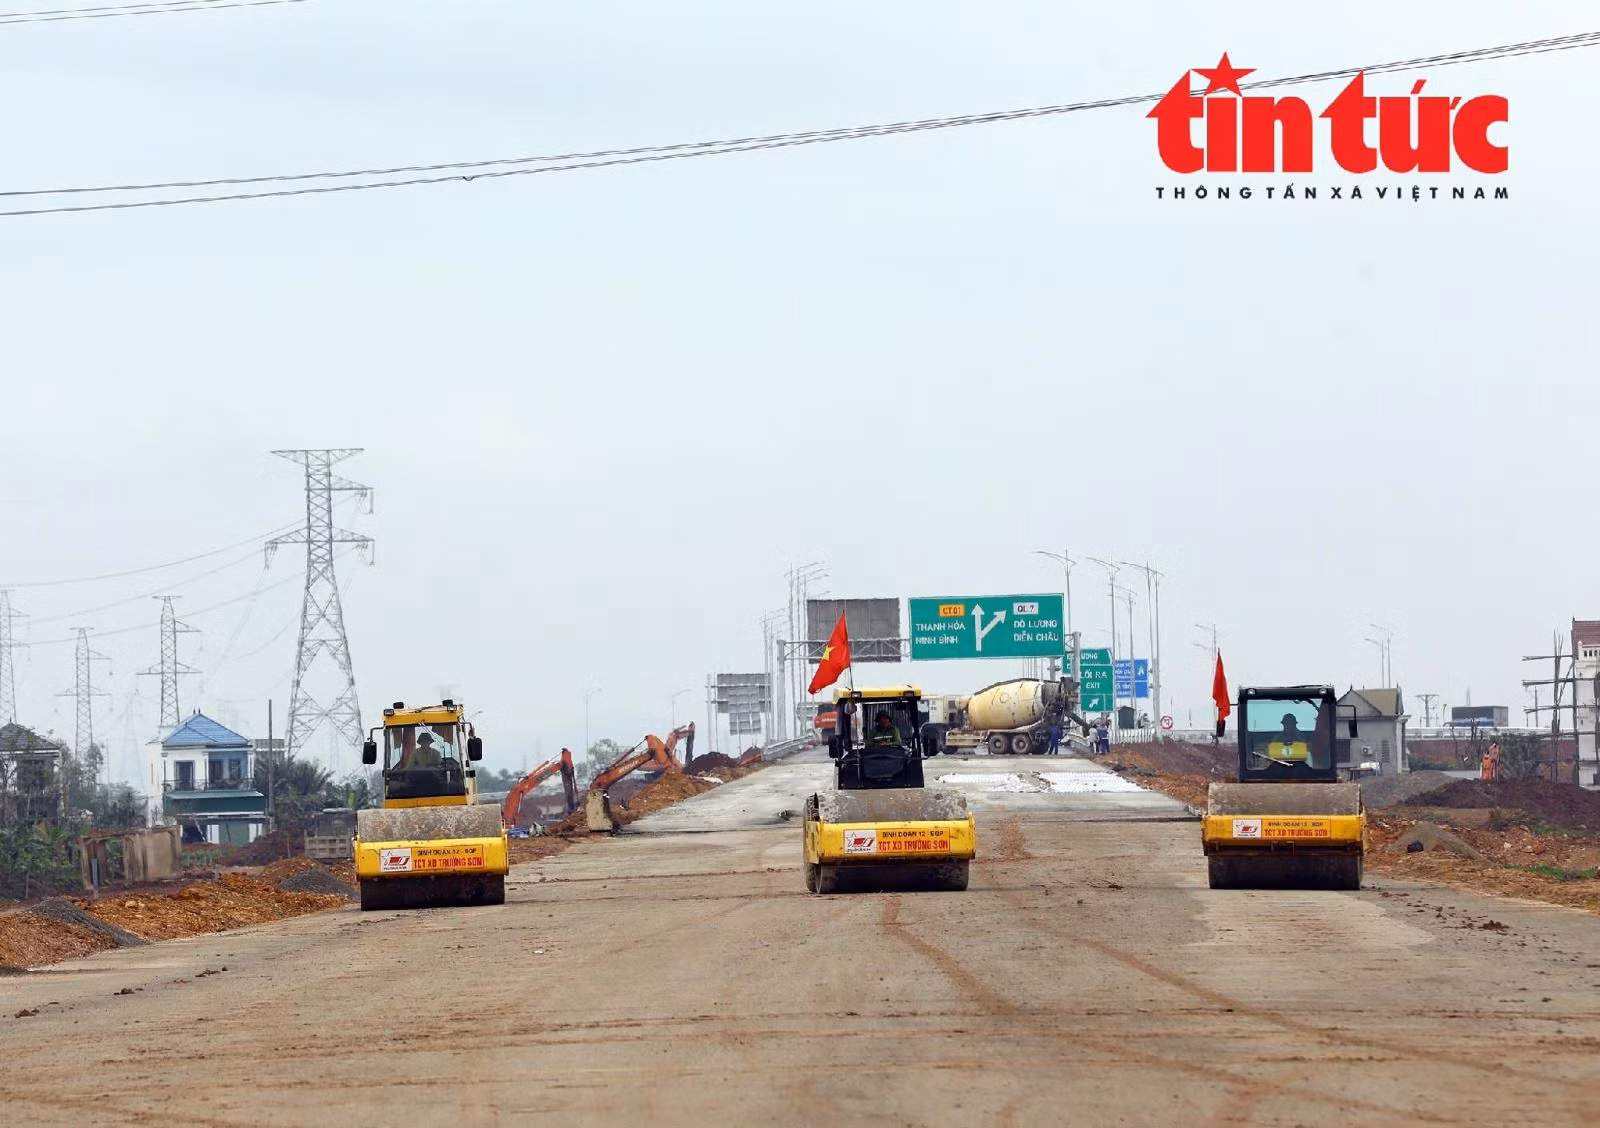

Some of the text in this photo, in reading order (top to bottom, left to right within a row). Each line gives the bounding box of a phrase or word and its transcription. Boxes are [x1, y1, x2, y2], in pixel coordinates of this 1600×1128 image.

[916, 623, 946, 631] THANH
[916, 637, 936, 645] NINH
[1095, 671, 1108, 679] RA
[879, 840, 890, 850] TCT
[414, 858, 426, 868] TCT
